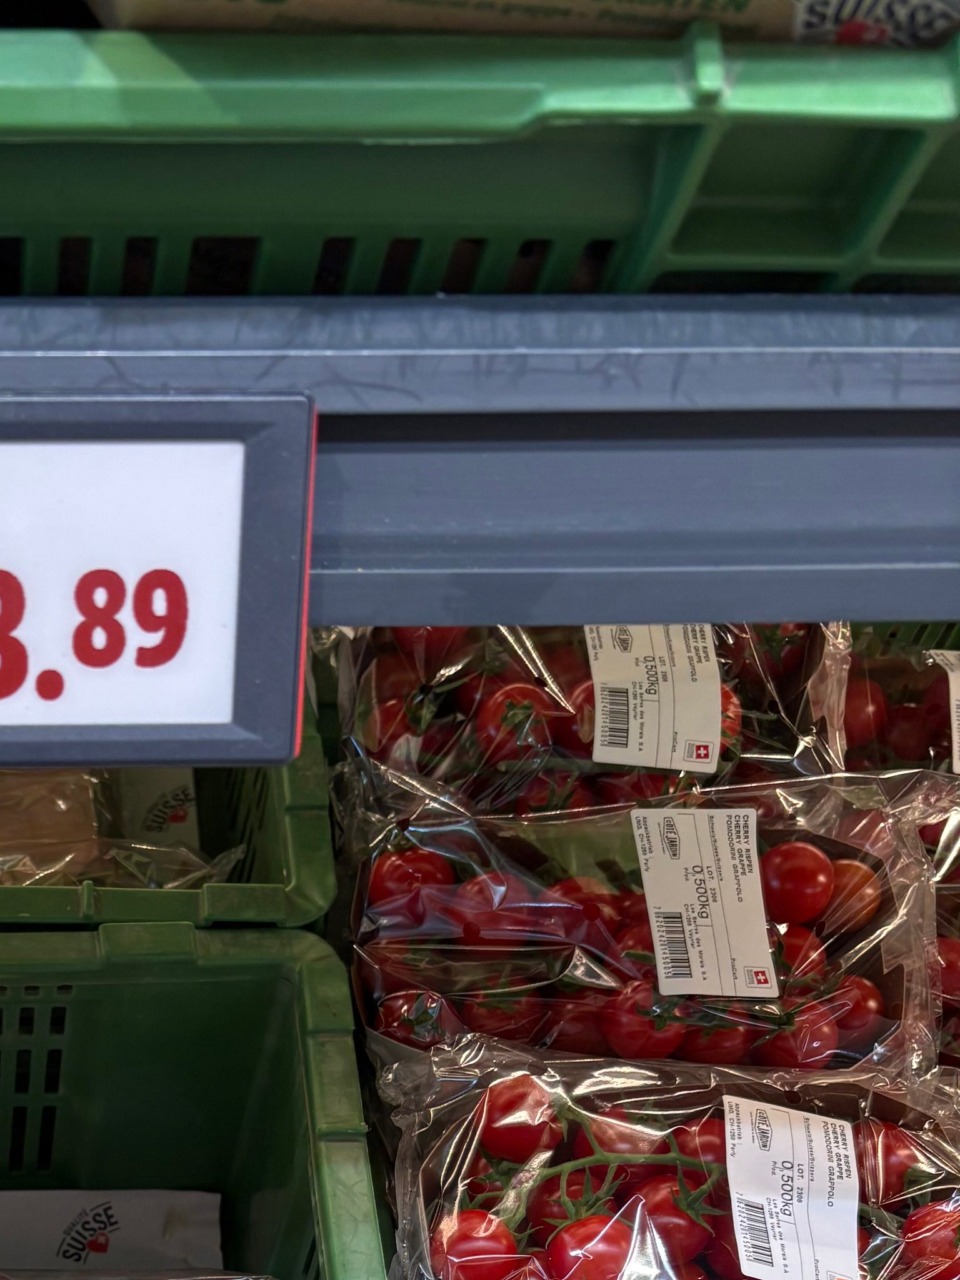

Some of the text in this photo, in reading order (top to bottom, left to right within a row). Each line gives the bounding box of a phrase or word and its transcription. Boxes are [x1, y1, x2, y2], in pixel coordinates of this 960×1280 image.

[643, 655, 659, 696] 0,500kg
[734, 814, 746, 876] CHERRY GRAPPE
[742, 814, 754, 874] CHERRY RISPEN
[691, 865, 710, 920] 0,500kg
[821, 1120, 835, 1208] POMODORINI GRAPPOLO
[830, 1122, 844, 1181] CHERRY GRAPPE
[838, 1124, 852, 1179] CHERRY RISPEN
[780, 1160, 794, 1218] 0,500kg
[62, 1205, 119, 1262] SUISSE
